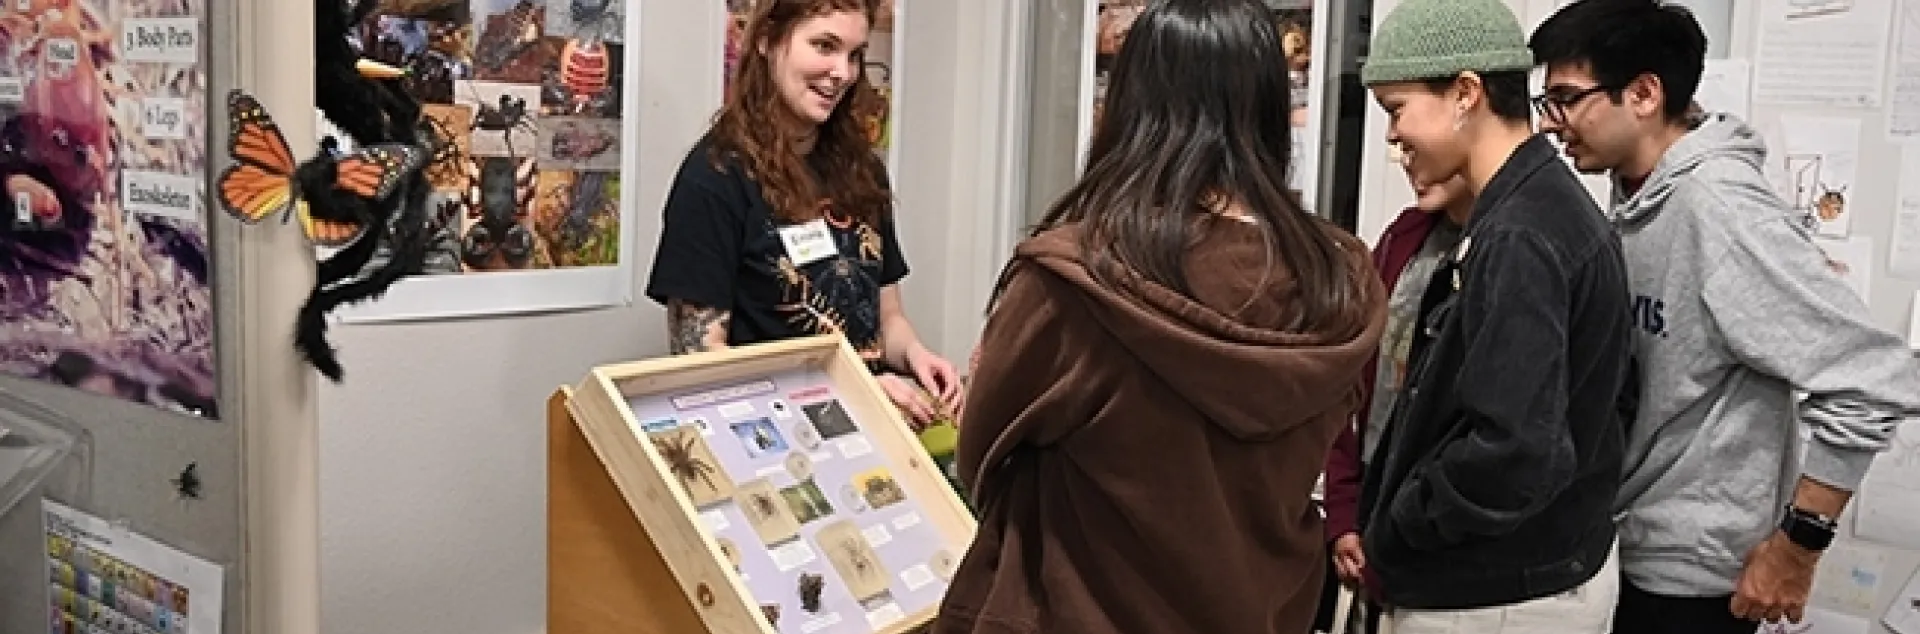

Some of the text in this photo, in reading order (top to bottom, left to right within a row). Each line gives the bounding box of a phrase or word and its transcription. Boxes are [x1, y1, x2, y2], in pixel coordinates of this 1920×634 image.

[137, 26, 165, 54] Body
[168, 26, 194, 48] Parts
[156, 104, 181, 132] Legs
[129, 181, 190, 210] Exoskeleton
